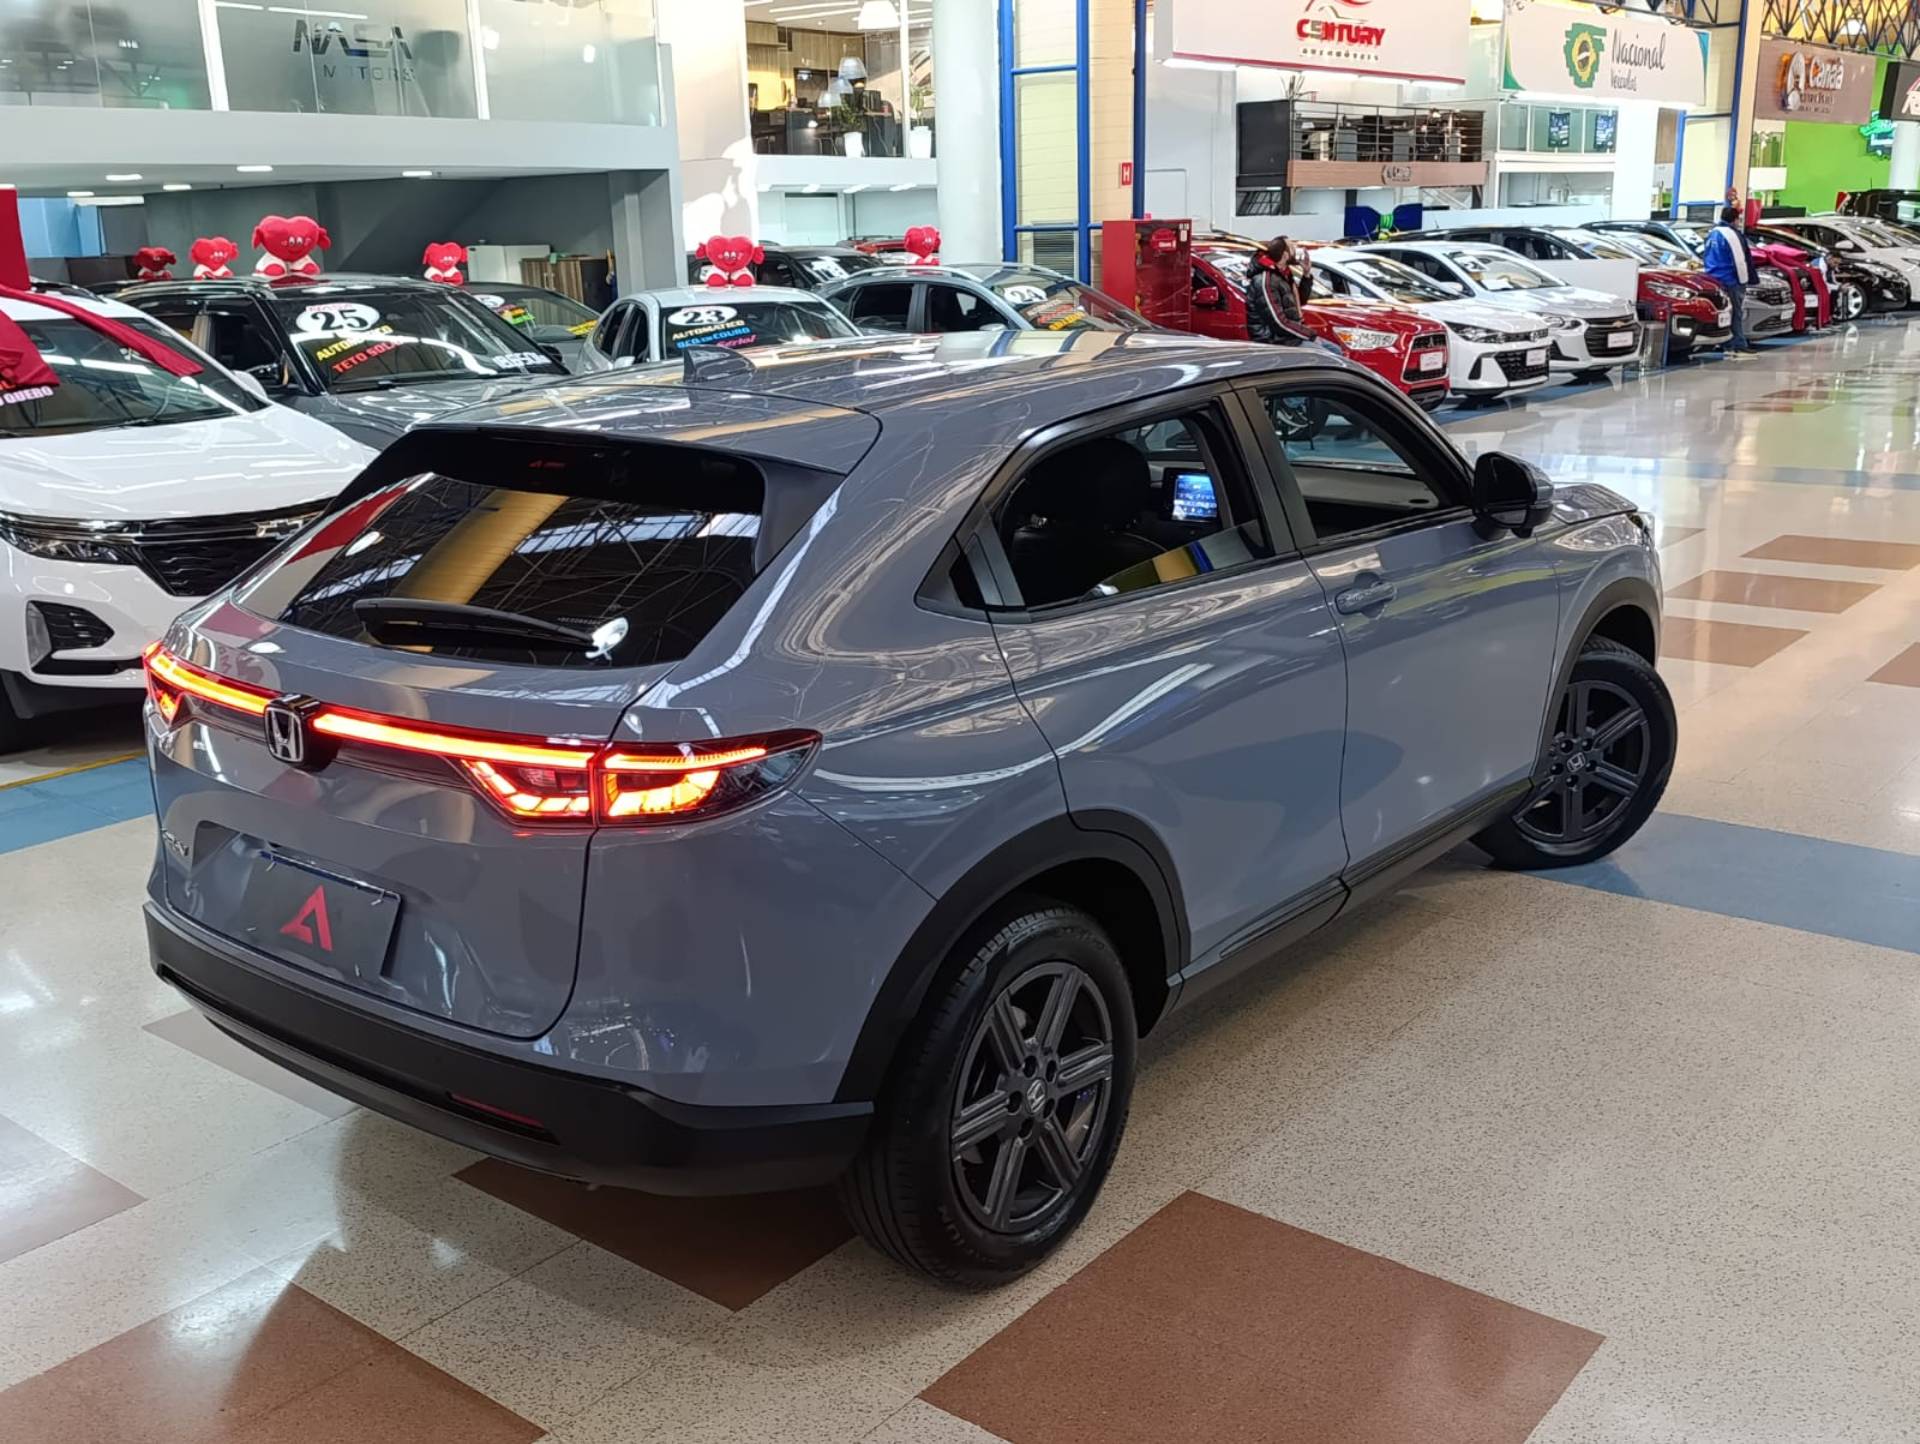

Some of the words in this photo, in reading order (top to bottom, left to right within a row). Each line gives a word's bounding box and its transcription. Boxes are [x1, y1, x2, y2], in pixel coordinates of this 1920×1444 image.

[293, 20, 412, 59] NASA
[1296, 19, 1386, 46] CENTURY
[1612, 28, 1666, 70] Nacional
[323, 64, 416, 81] MTORS
[1123, 165, 1131, 183] H
[1010, 288, 1044, 302] 24
[311, 309, 368, 331] 25
[683, 310, 726, 325] 23
[332, 353, 368, 373] TETO
